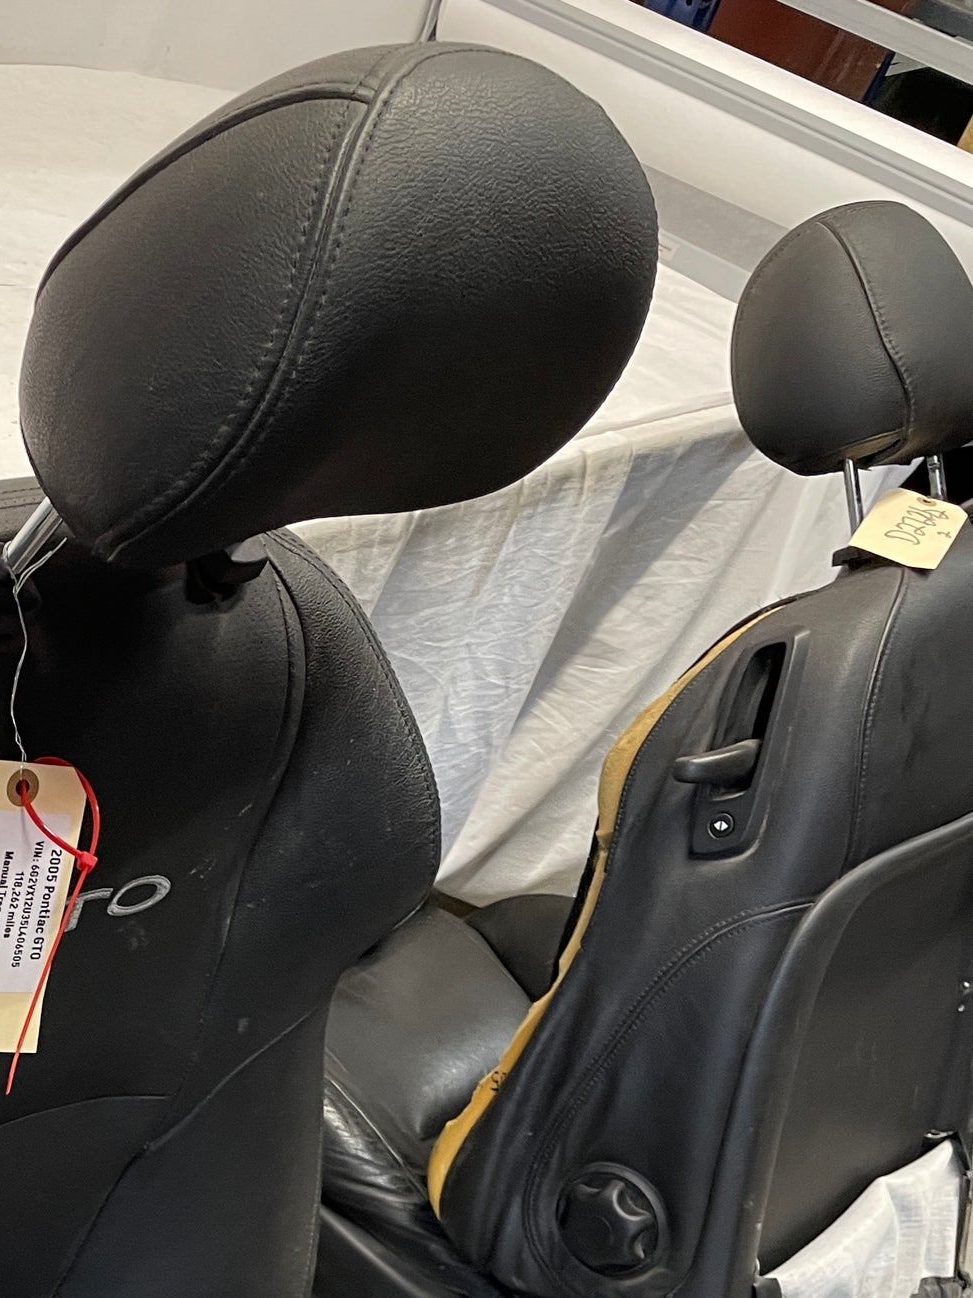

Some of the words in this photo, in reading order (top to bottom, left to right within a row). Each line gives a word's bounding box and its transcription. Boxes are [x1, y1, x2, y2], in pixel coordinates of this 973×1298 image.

[32, 841, 45, 862] VIN:
[47, 849, 62, 882] 2005
[0, 851, 14, 889] Manual
[10, 871, 24, 909] 118,262
[64, 874, 172, 933] TO
[3, 911, 15, 938] miles
[35, 886, 55, 934] Pontiac
[30, 937, 44, 960] GTO
